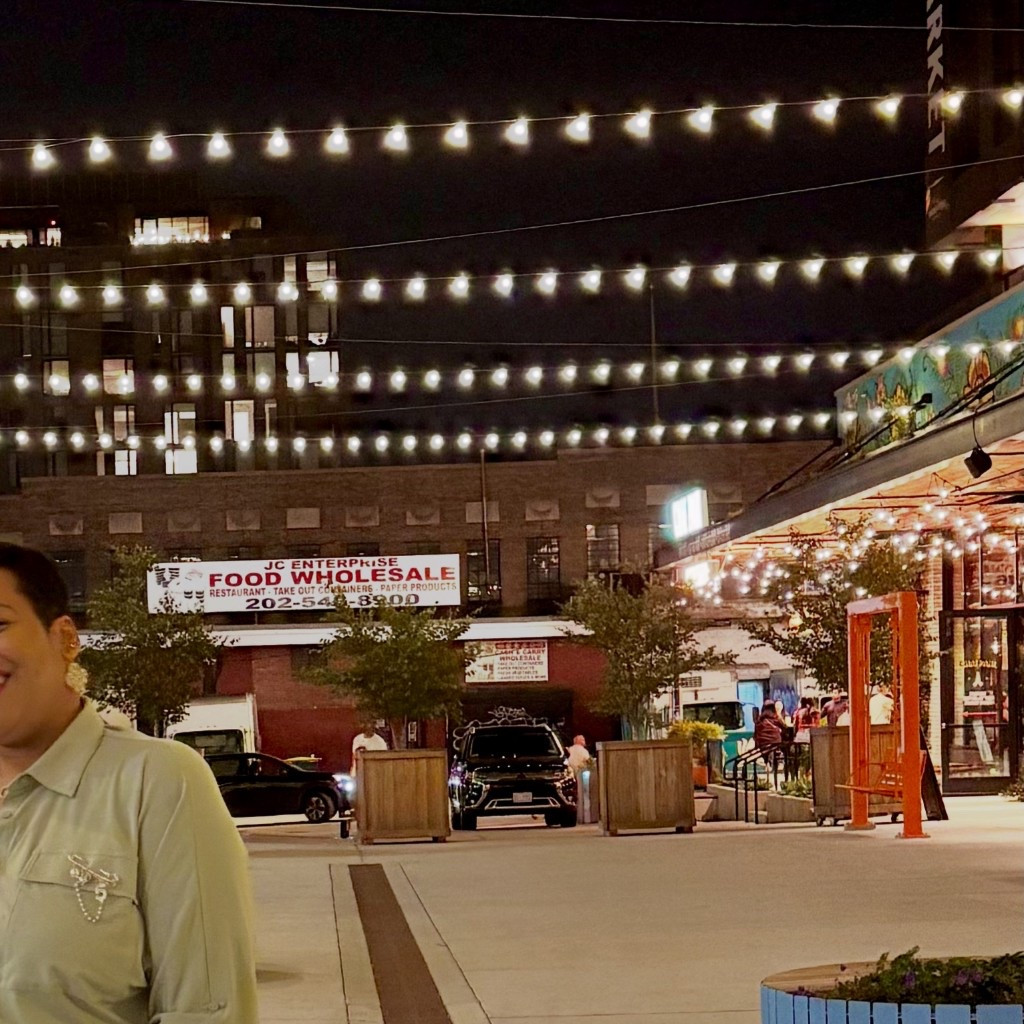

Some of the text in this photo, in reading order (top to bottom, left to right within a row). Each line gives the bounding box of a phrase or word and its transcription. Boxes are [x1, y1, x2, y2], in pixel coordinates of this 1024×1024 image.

[926, 0, 945, 154] RKET
[264, 557, 398, 570] JC ENTERPRISE
[209, 566, 455, 587] FOOD WHOLESALE
[209, 587, 266, 597] RESTAURANT
[273, 586, 295, 596] TAKE
[297, 586, 316, 595] OUT
[380, 583, 408, 593] PAPER
[410, 582, 457, 592] PRODUCTS
